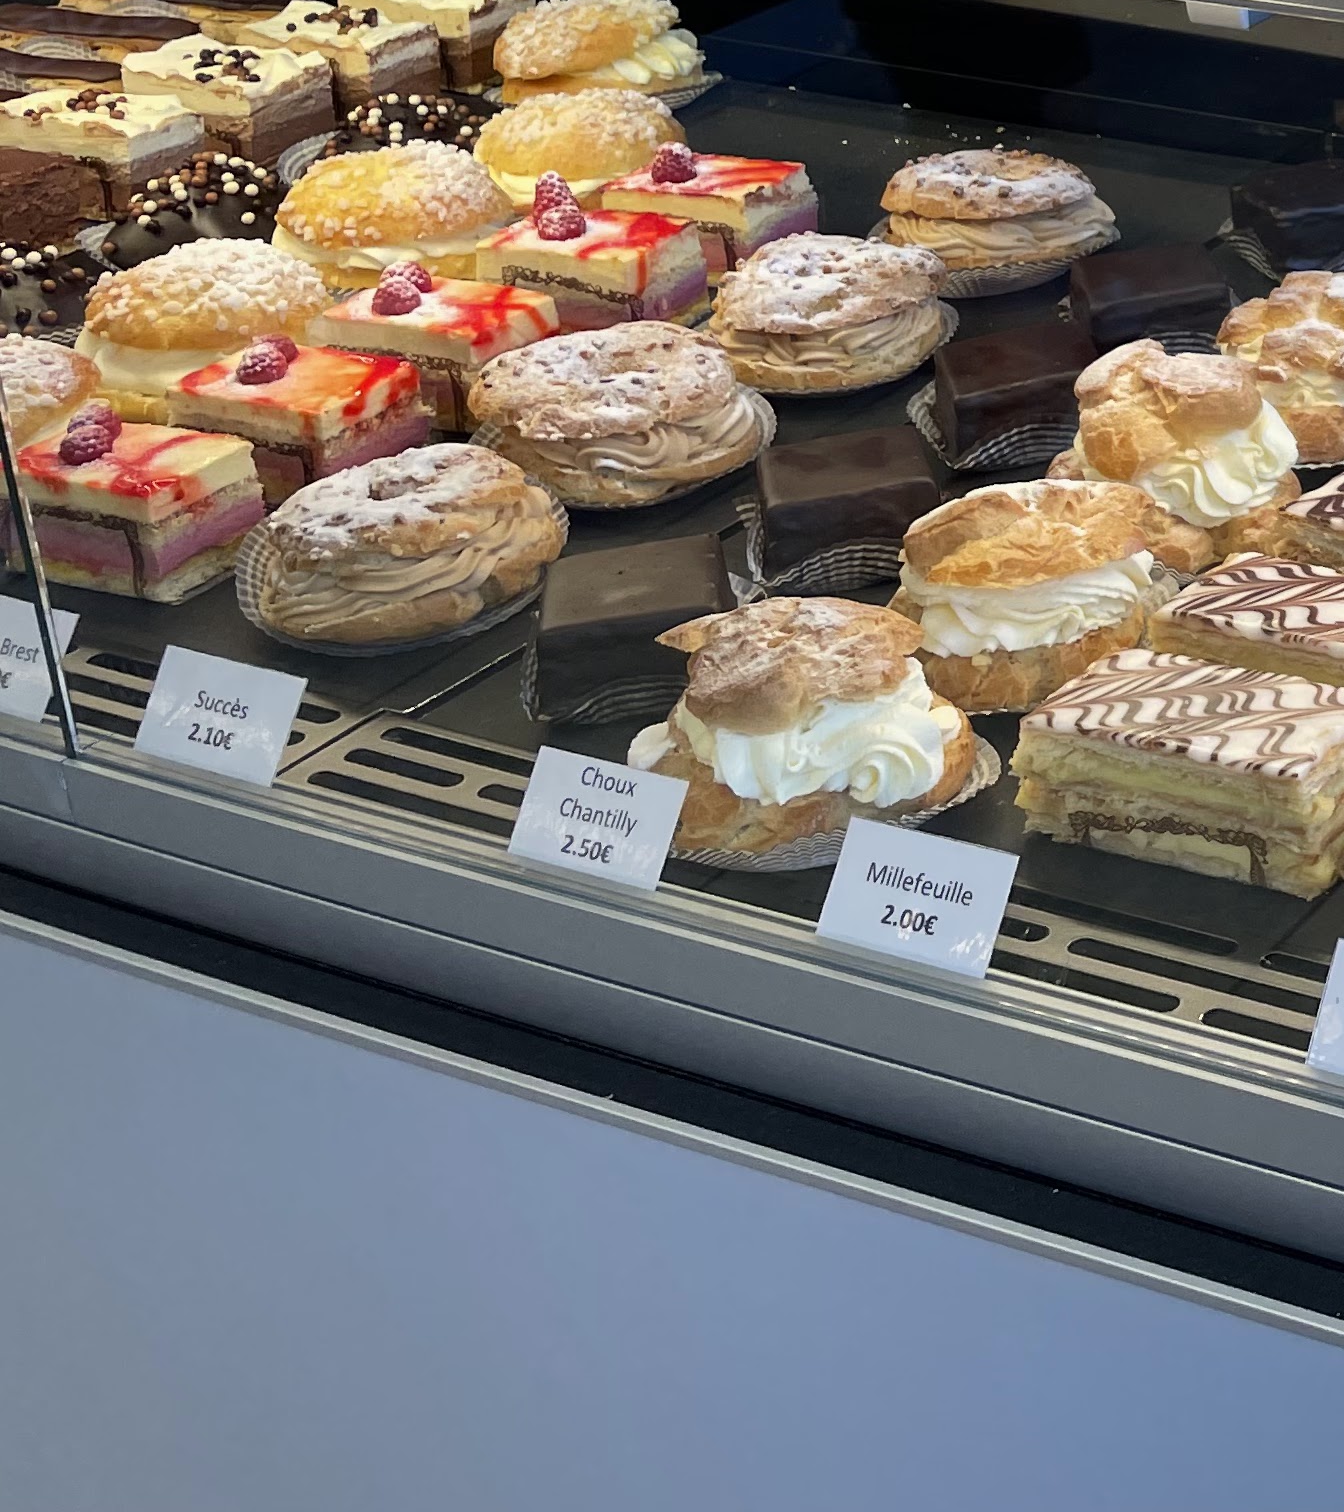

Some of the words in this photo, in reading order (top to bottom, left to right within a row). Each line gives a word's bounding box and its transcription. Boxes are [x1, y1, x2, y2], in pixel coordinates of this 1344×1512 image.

[0, 638, 40, 663] Brest
[194, 690, 249, 720] Succès
[187, 723, 236, 750] 2.10€
[580, 765, 638, 798] Choux
[559, 796, 639, 838] Chantilly
[560, 834, 615, 865] 2.50€
[866, 861, 974, 907] Millefeuille
[880, 904, 939, 936] 2.00€
